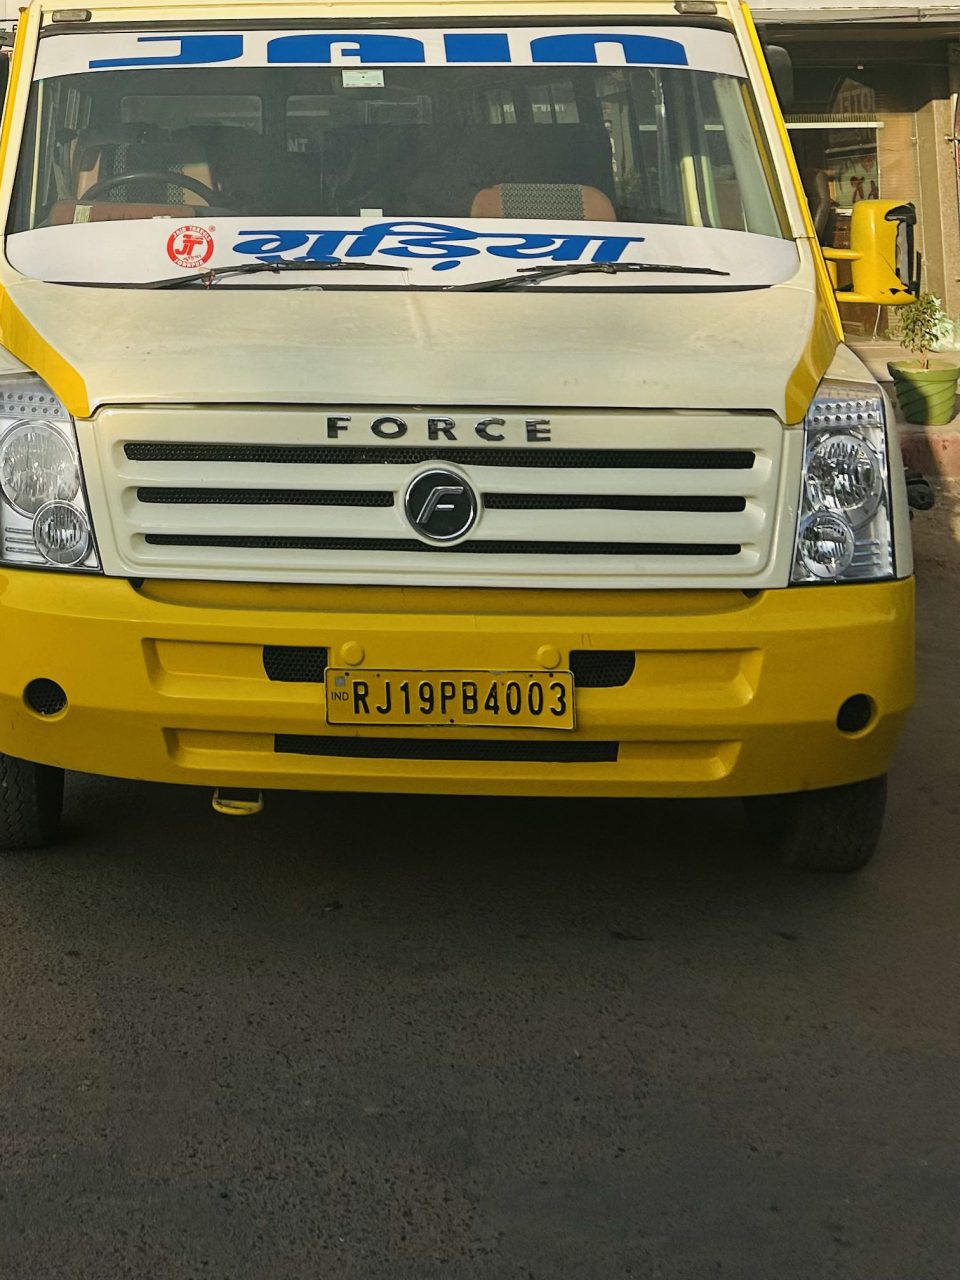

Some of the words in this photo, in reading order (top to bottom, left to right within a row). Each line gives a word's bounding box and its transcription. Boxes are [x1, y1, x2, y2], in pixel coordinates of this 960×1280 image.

[232, 221, 646, 271] गुड़िया
[326, 416, 552, 442] FORCE
[331, 691, 349, 702] IND
[352, 681, 568, 716] RJ19PB4003
